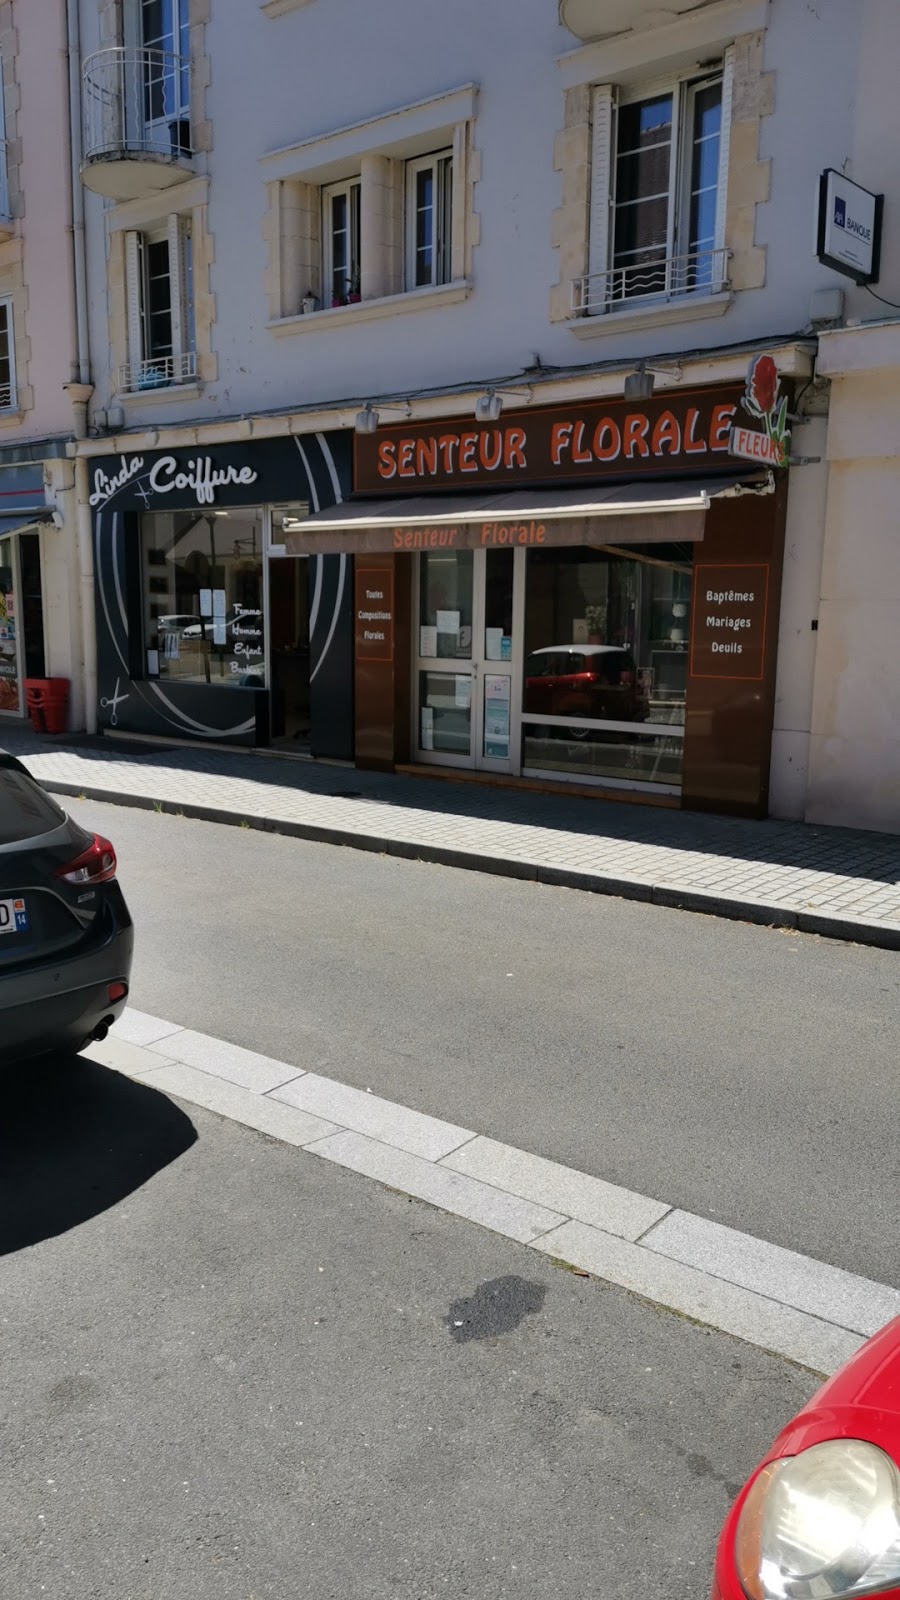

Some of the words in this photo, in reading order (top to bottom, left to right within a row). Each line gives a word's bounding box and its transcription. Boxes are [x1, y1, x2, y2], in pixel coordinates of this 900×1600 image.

[847, 218, 871, 240] BANQUE
[377, 427, 527, 479] SENTEUR
[551, 404, 737, 465] FLORALE
[738, 431, 785, 462] FLEURS
[89, 454, 144, 506] Linda
[149, 456, 258, 504] Coiffure
[392, 528, 457, 549] Senteur
[481, 521, 546, 545] Florale
[365, 590, 383, 599] Toutes
[706, 590, 754, 605] Baptêmes
[233, 603, 261, 615] Femme
[358, 610, 391, 621] Compositions
[232, 622, 261, 635] Homme
[706, 616, 751, 631] Mariages
[364, 630, 384, 640] Florales
[233, 642, 262, 660] Enfant
[711, 641, 742, 654] Deuils
[229, 661, 263, 676] Barbier
[17, 914, 26, 925] 14
